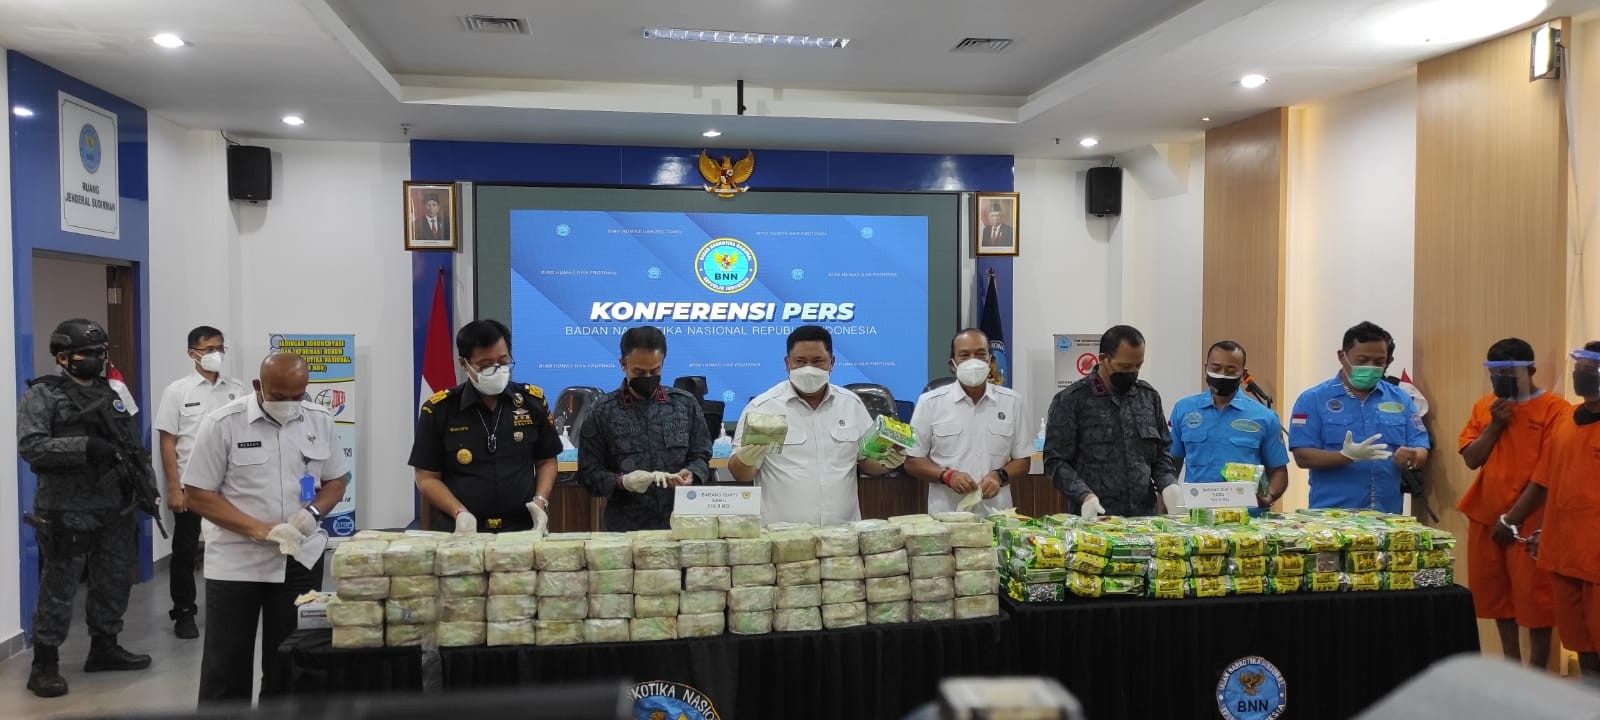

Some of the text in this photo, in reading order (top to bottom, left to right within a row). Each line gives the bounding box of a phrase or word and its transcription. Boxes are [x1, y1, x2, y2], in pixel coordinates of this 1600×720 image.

[82, 181, 100, 195] RUANG
[65, 192, 90, 207] JENDERAL
[714, 272, 738, 281] BNN
[589, 300, 856, 322] KONFERENSI PERS
[565, 326, 877, 335] BADAN NAIKA NASIONAL REPUB DONESIA
[631, 682, 715, 720] KOTIKA NASIO
[1237, 700, 1269, 712] BNN
